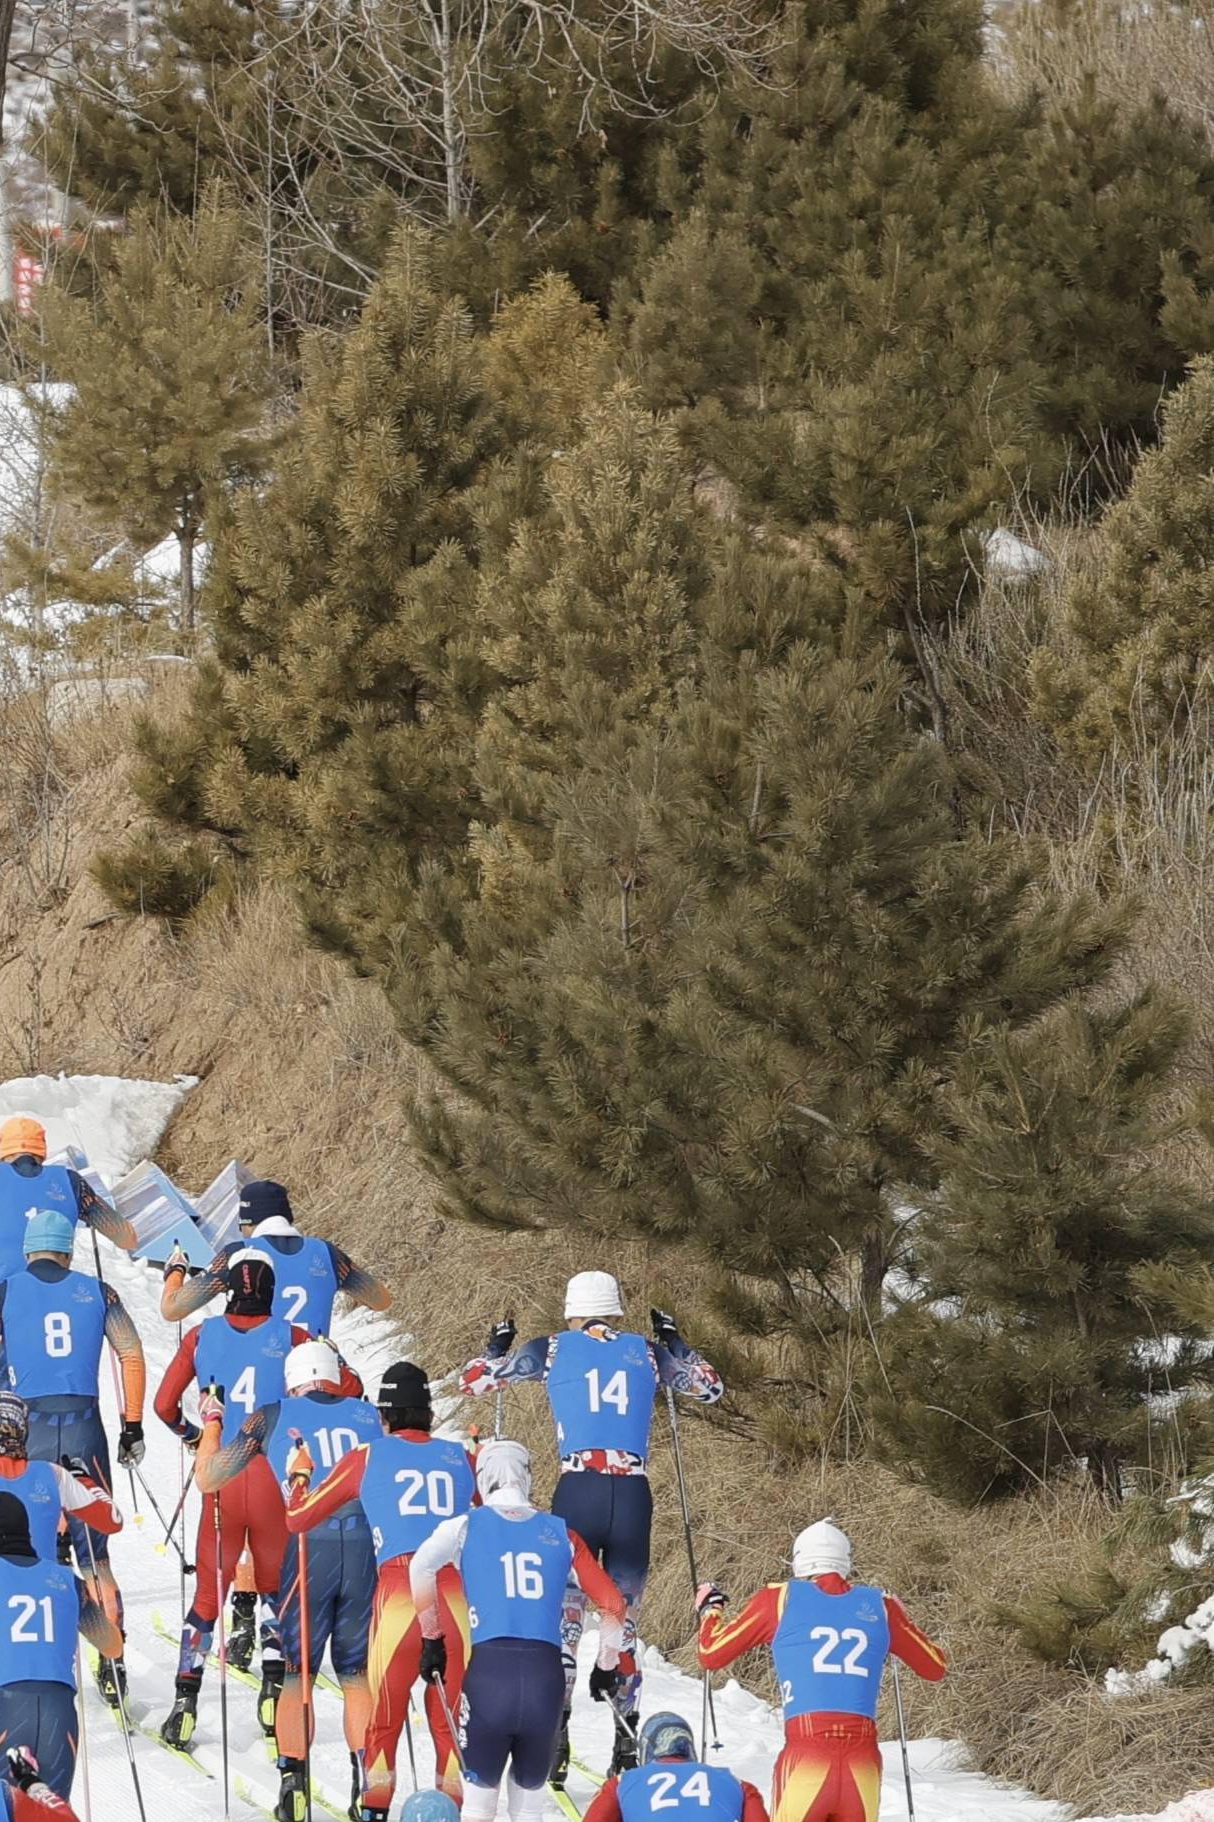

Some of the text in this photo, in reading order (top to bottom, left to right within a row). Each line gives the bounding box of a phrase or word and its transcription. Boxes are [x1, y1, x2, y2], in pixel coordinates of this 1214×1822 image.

[282, 1286, 308, 1331] 2
[45, 1312, 71, 1357] 8
[230, 1367, 256, 1406] 4
[585, 1369, 628, 1414] 14
[314, 1427, 359, 1467] 10
[395, 1470, 454, 1516] 20
[501, 1552, 543, 1599] 16
[8, 1595, 53, 1642] 21
[811, 1627, 867, 1676] 22
[648, 1772, 710, 1811] 24
